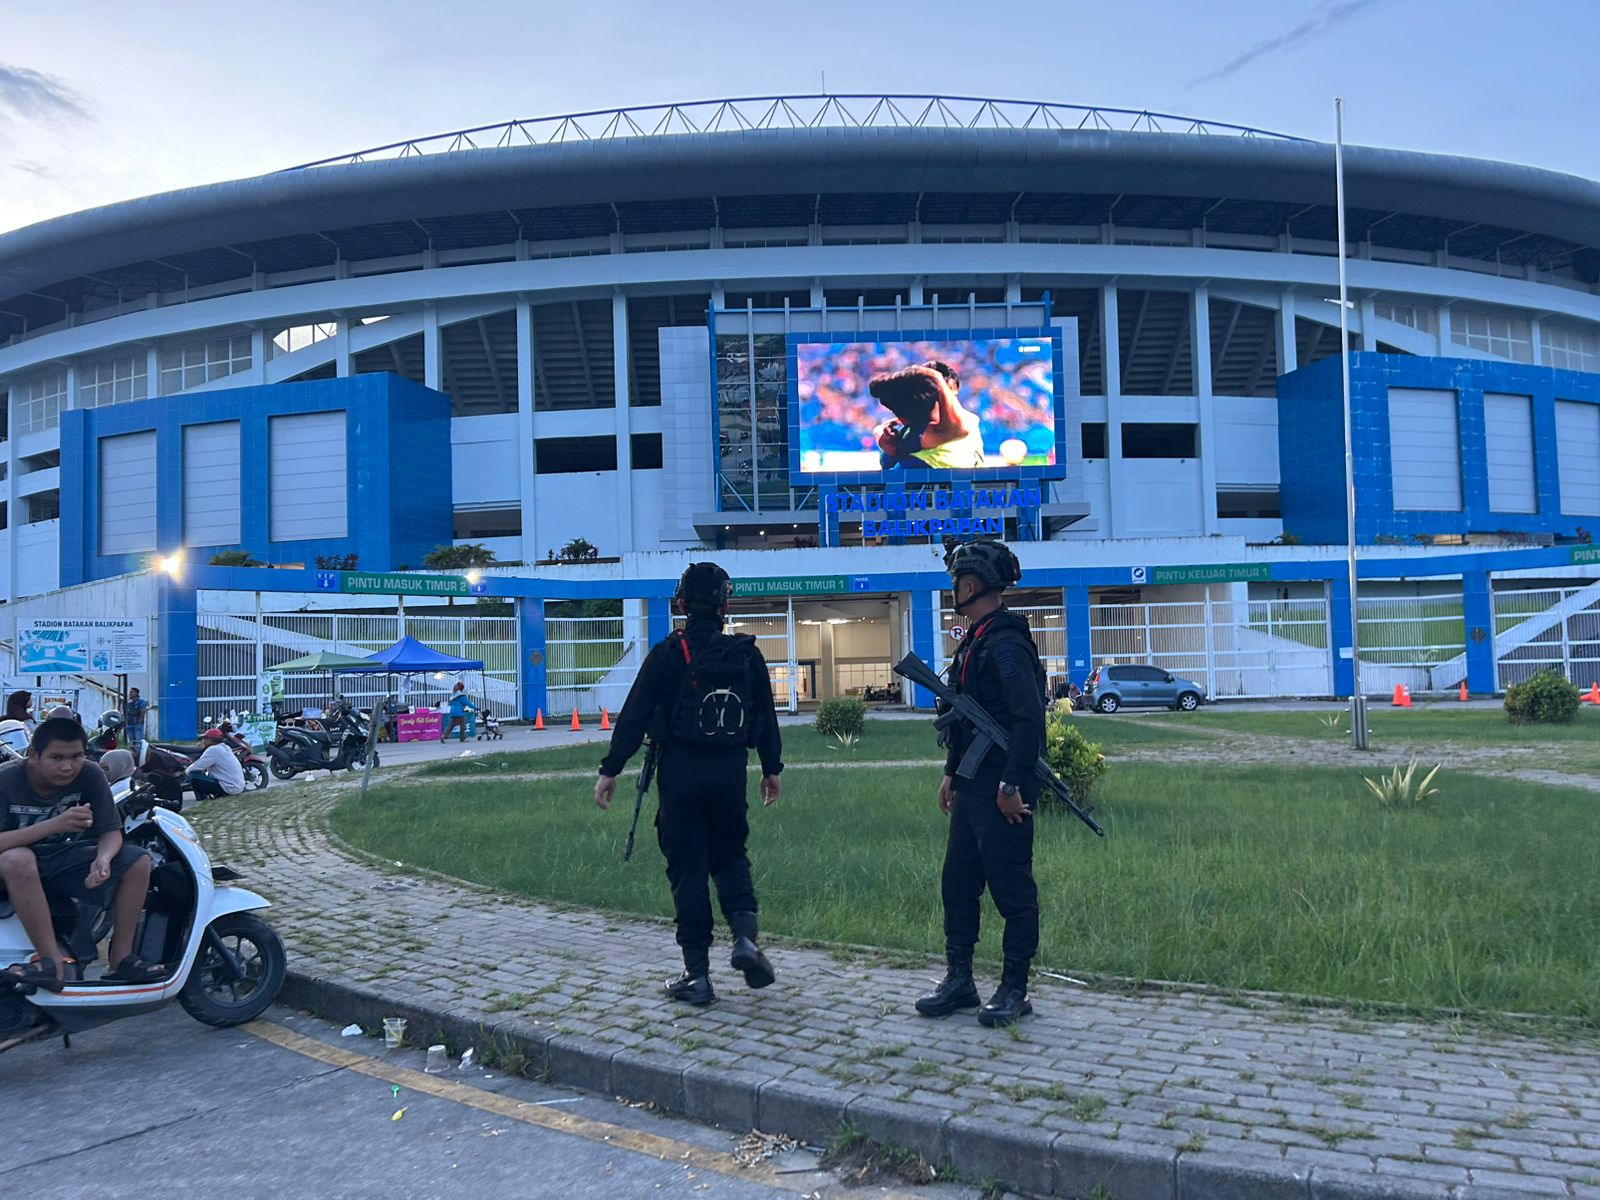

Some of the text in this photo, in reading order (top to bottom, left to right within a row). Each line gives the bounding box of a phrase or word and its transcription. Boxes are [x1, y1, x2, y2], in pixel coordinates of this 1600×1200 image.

[827, 487, 1041, 513] STADION BATAKAN
[863, 517, 1004, 537] BALIKPAPAN
[1156, 567, 1268, 581] PINTU KELUAR TIMUR 1
[348, 577, 381, 589] PINTU
[384, 578, 423, 591] MASUK
[425, 580, 457, 592] TIMUR
[459, 581, 467, 592] 2
[735, 579, 844, 592] PINTU MASUK TIMUR 1
